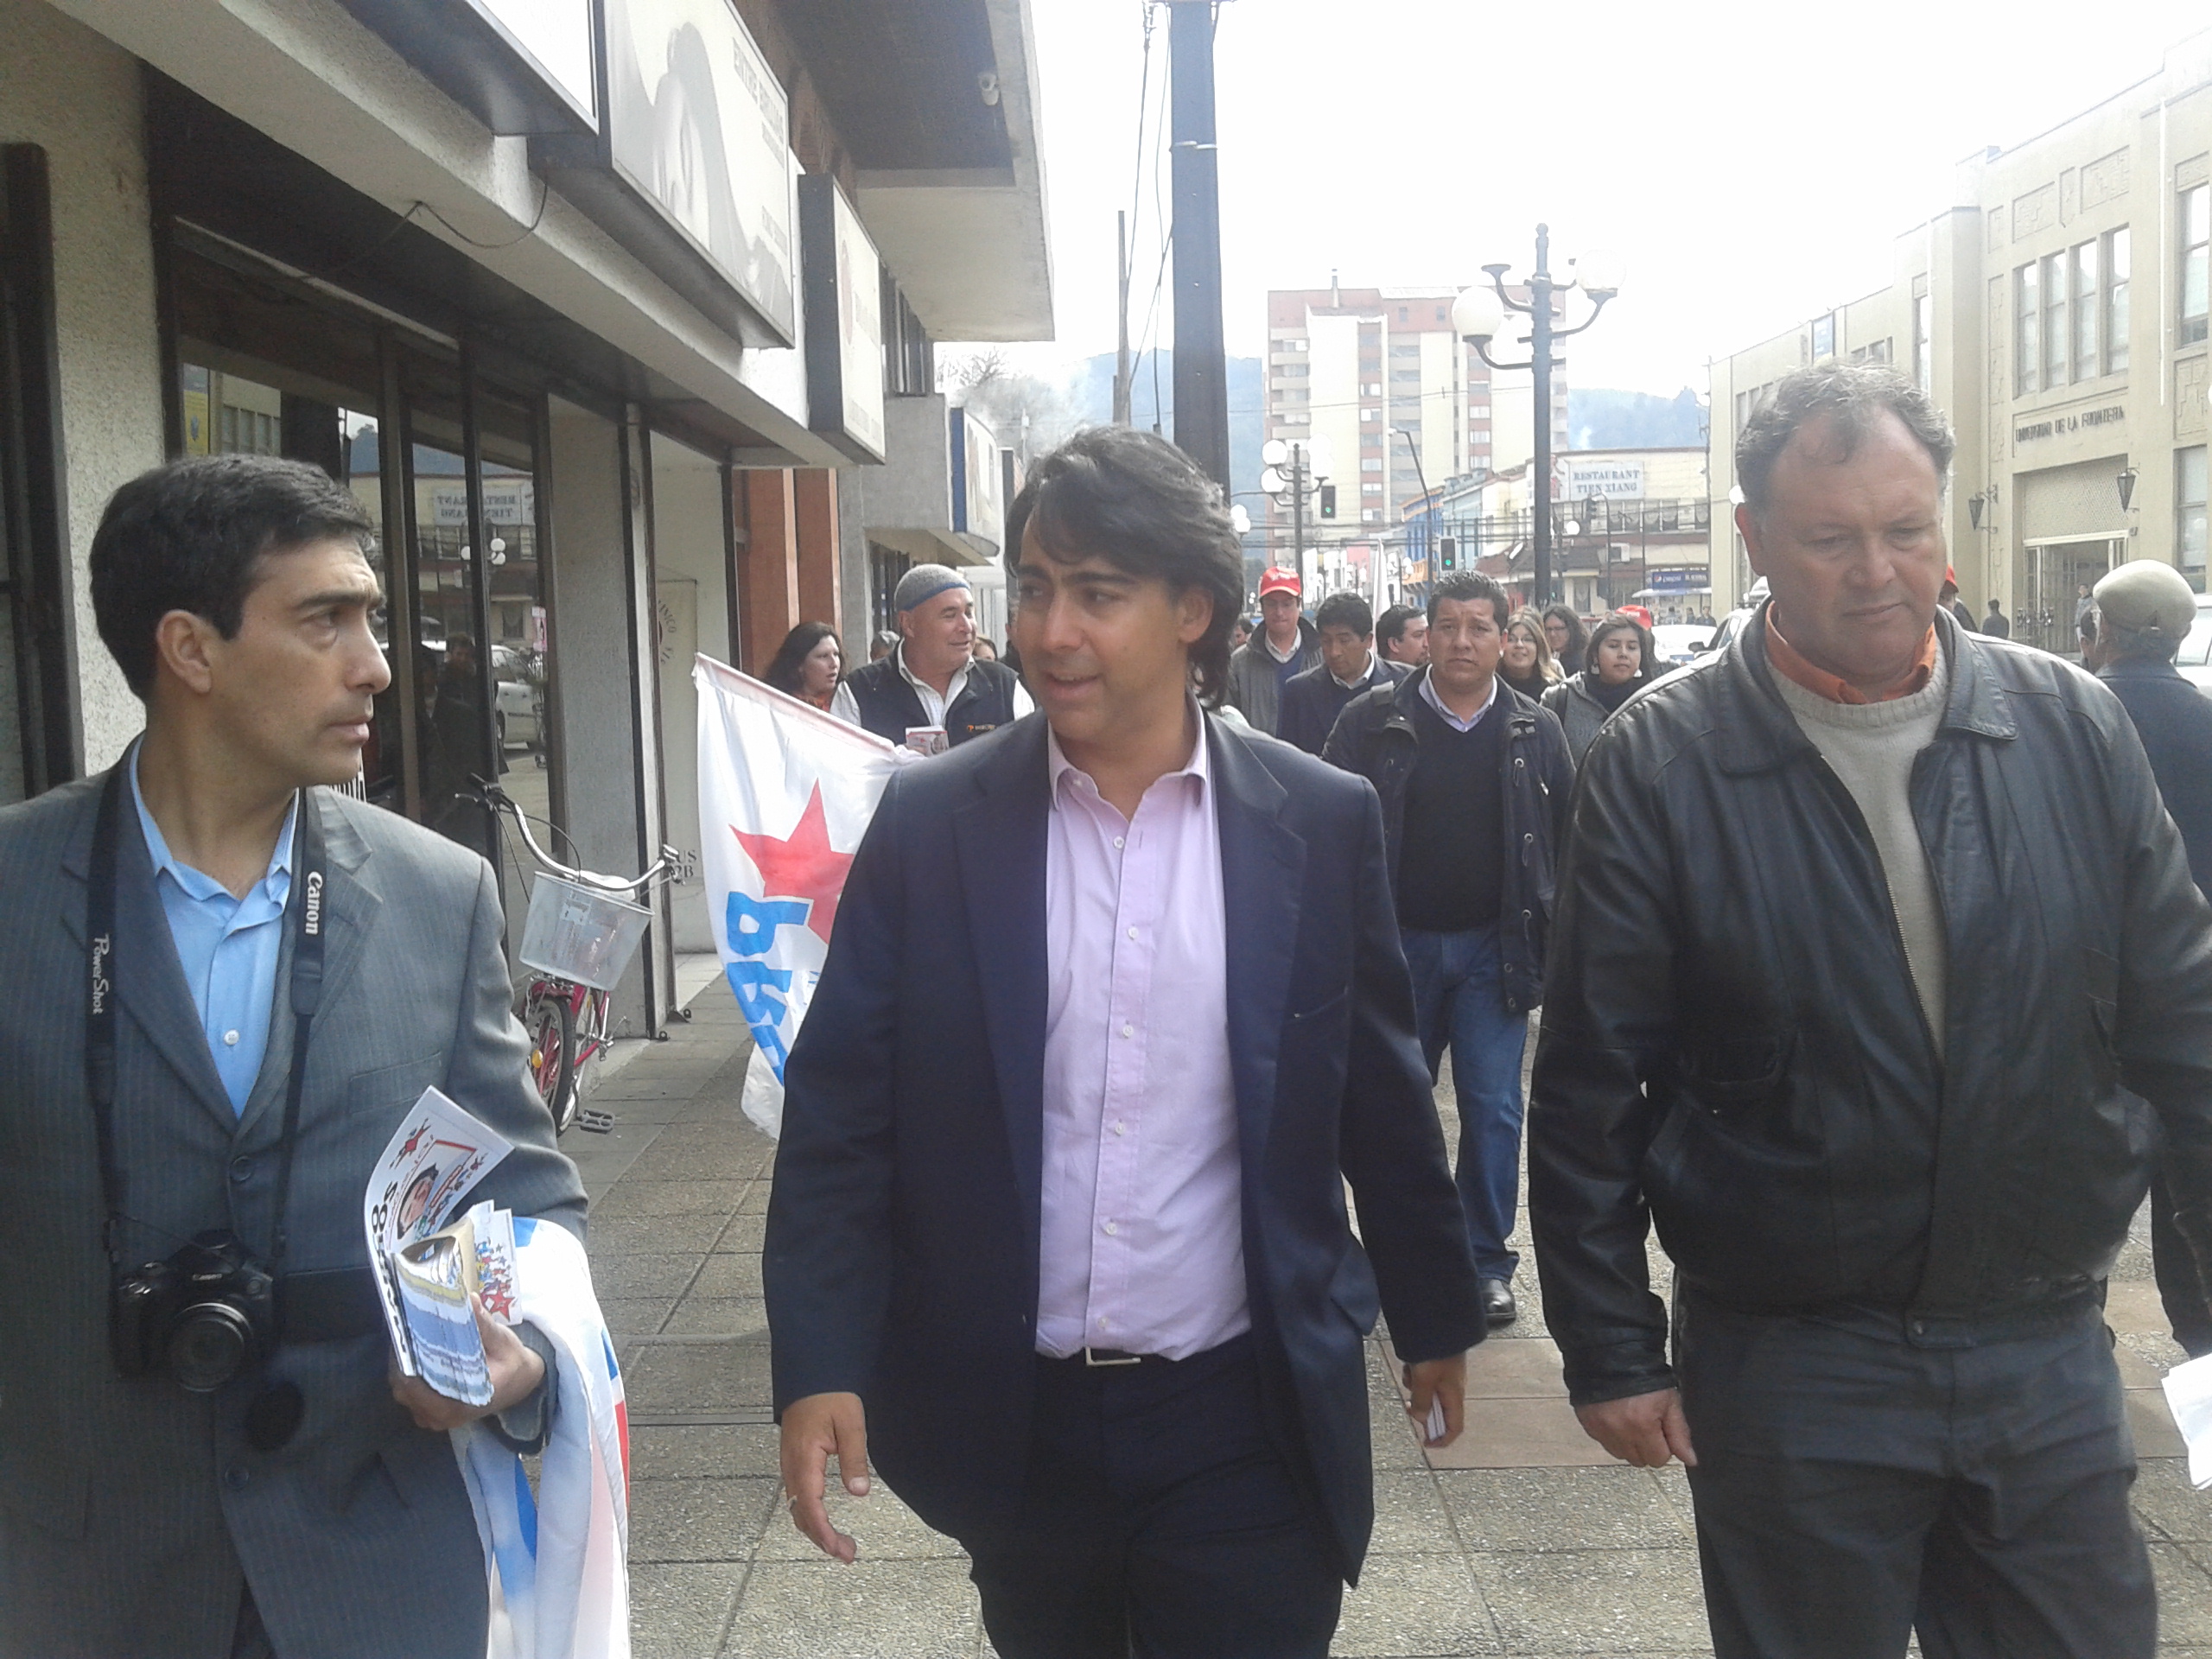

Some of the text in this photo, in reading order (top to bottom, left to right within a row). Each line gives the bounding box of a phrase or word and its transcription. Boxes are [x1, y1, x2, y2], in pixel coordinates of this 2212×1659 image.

[2068, 416, 2078, 431] LA
[1573, 470, 1640, 480] RESTAURANT
[1577, 483, 1602, 493] TIEN
[306, 871, 323, 935] Canon
[92, 933, 110, 1014] PowerShot
